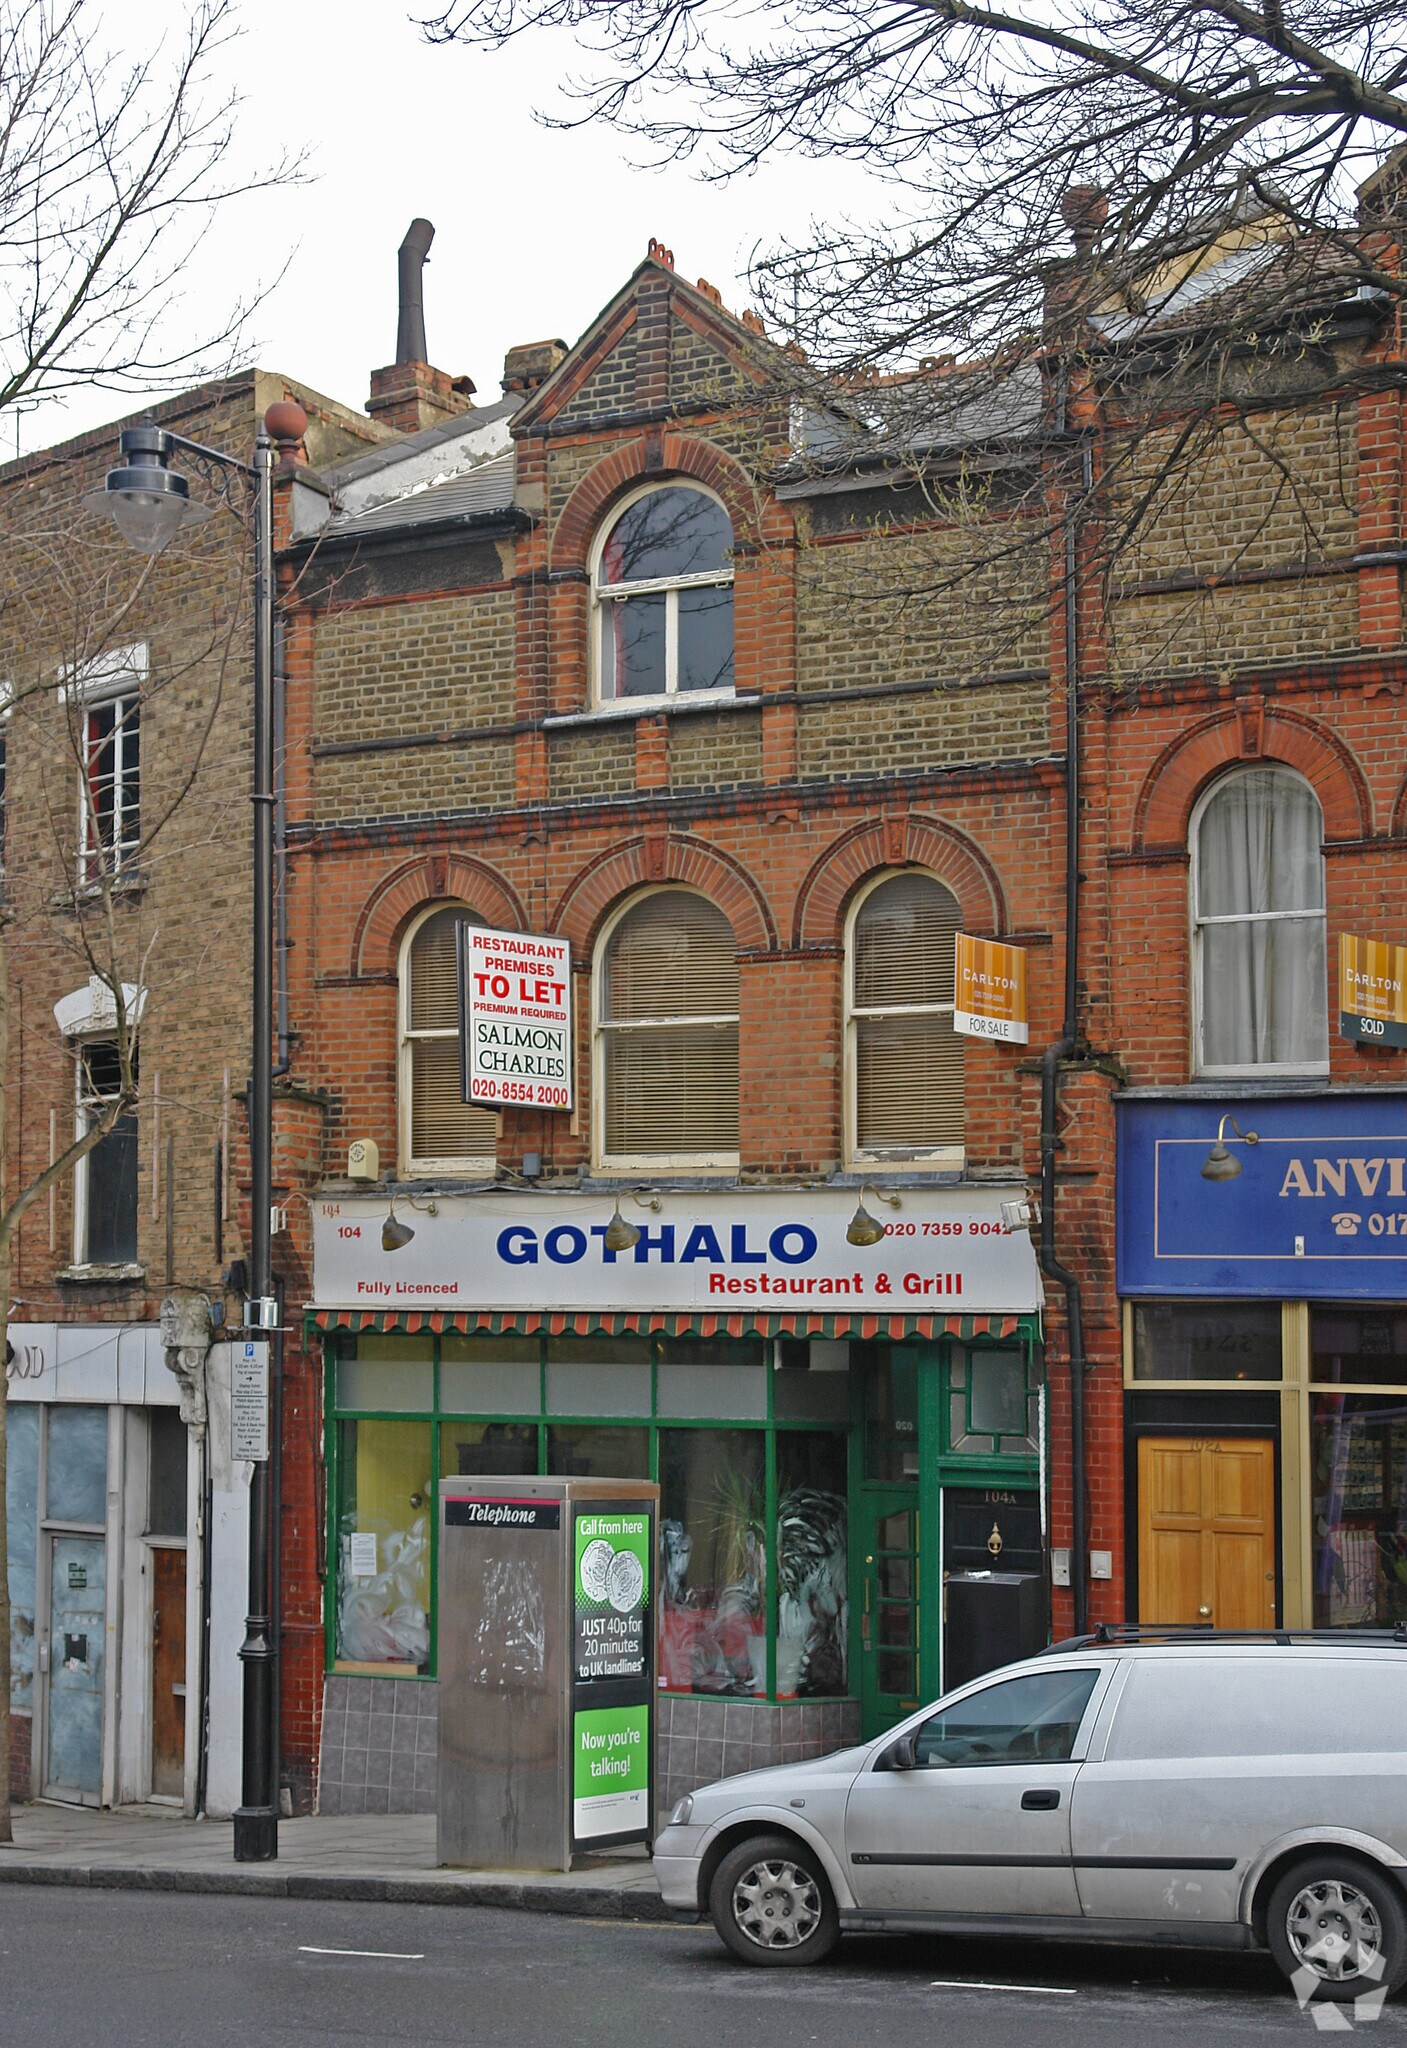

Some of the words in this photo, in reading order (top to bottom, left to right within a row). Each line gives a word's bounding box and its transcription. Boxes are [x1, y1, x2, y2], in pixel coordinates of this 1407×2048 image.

[473, 936, 565, 960] RESTAURANT
[485, 956, 555, 977] PREMISES
[473, 973, 510, 999] TO
[519, 978, 566, 1005] LET
[963, 968, 1018, 990] CARLTON
[1346, 968, 1401, 991] CARLTON
[473, 1002, 518, 1016] PREMIUM
[520, 1007, 567, 1021] REQUIRED
[478, 1023, 564, 1051] SALMON
[969, 1018, 986, 1033] FOR
[987, 1021, 1009, 1037] SALE
[1360, 1017, 1385, 1035] SOLD
[479, 1050, 564, 1077] CHARLES
[472, 1078, 534, 1102] 020-8554
[537, 1085, 568, 1105] 2000
[1279, 1158, 1406, 1197] ANVI
[322, 1204, 340, 1216] 104
[337, 1226, 361, 1238] 104
[884, 1223, 916, 1236] 020
[921, 1223, 963, 1236] 7359
[357, 1281, 391, 1295] Fully
[396, 1281, 458, 1294] Licenced
[709, 1272, 864, 1294] Restaurant
[874, 1272, 893, 1294] &
[903, 1272, 963, 1295] Grill
[984, 1490, 1017, 1504] 104A
[468, 1503, 536, 1525] Telephone
[580, 1519, 597, 1536] Call
[598, 1518, 620, 1535] from
[621, 1517, 643, 1534] here
[581, 1618, 606, 1636] JUST
[607, 1617, 627, 1637] 40p
[628, 1615, 642, 1633] for
[584, 1639, 598, 1656] 20
[600, 1638, 639, 1655] minutes
[579, 1664, 589, 1677] to
[590, 1661, 604, 1676] UK
[581, 1731, 606, 1750] Now
[607, 1726, 641, 1751] you're
[590, 1754, 631, 1777] talking!
